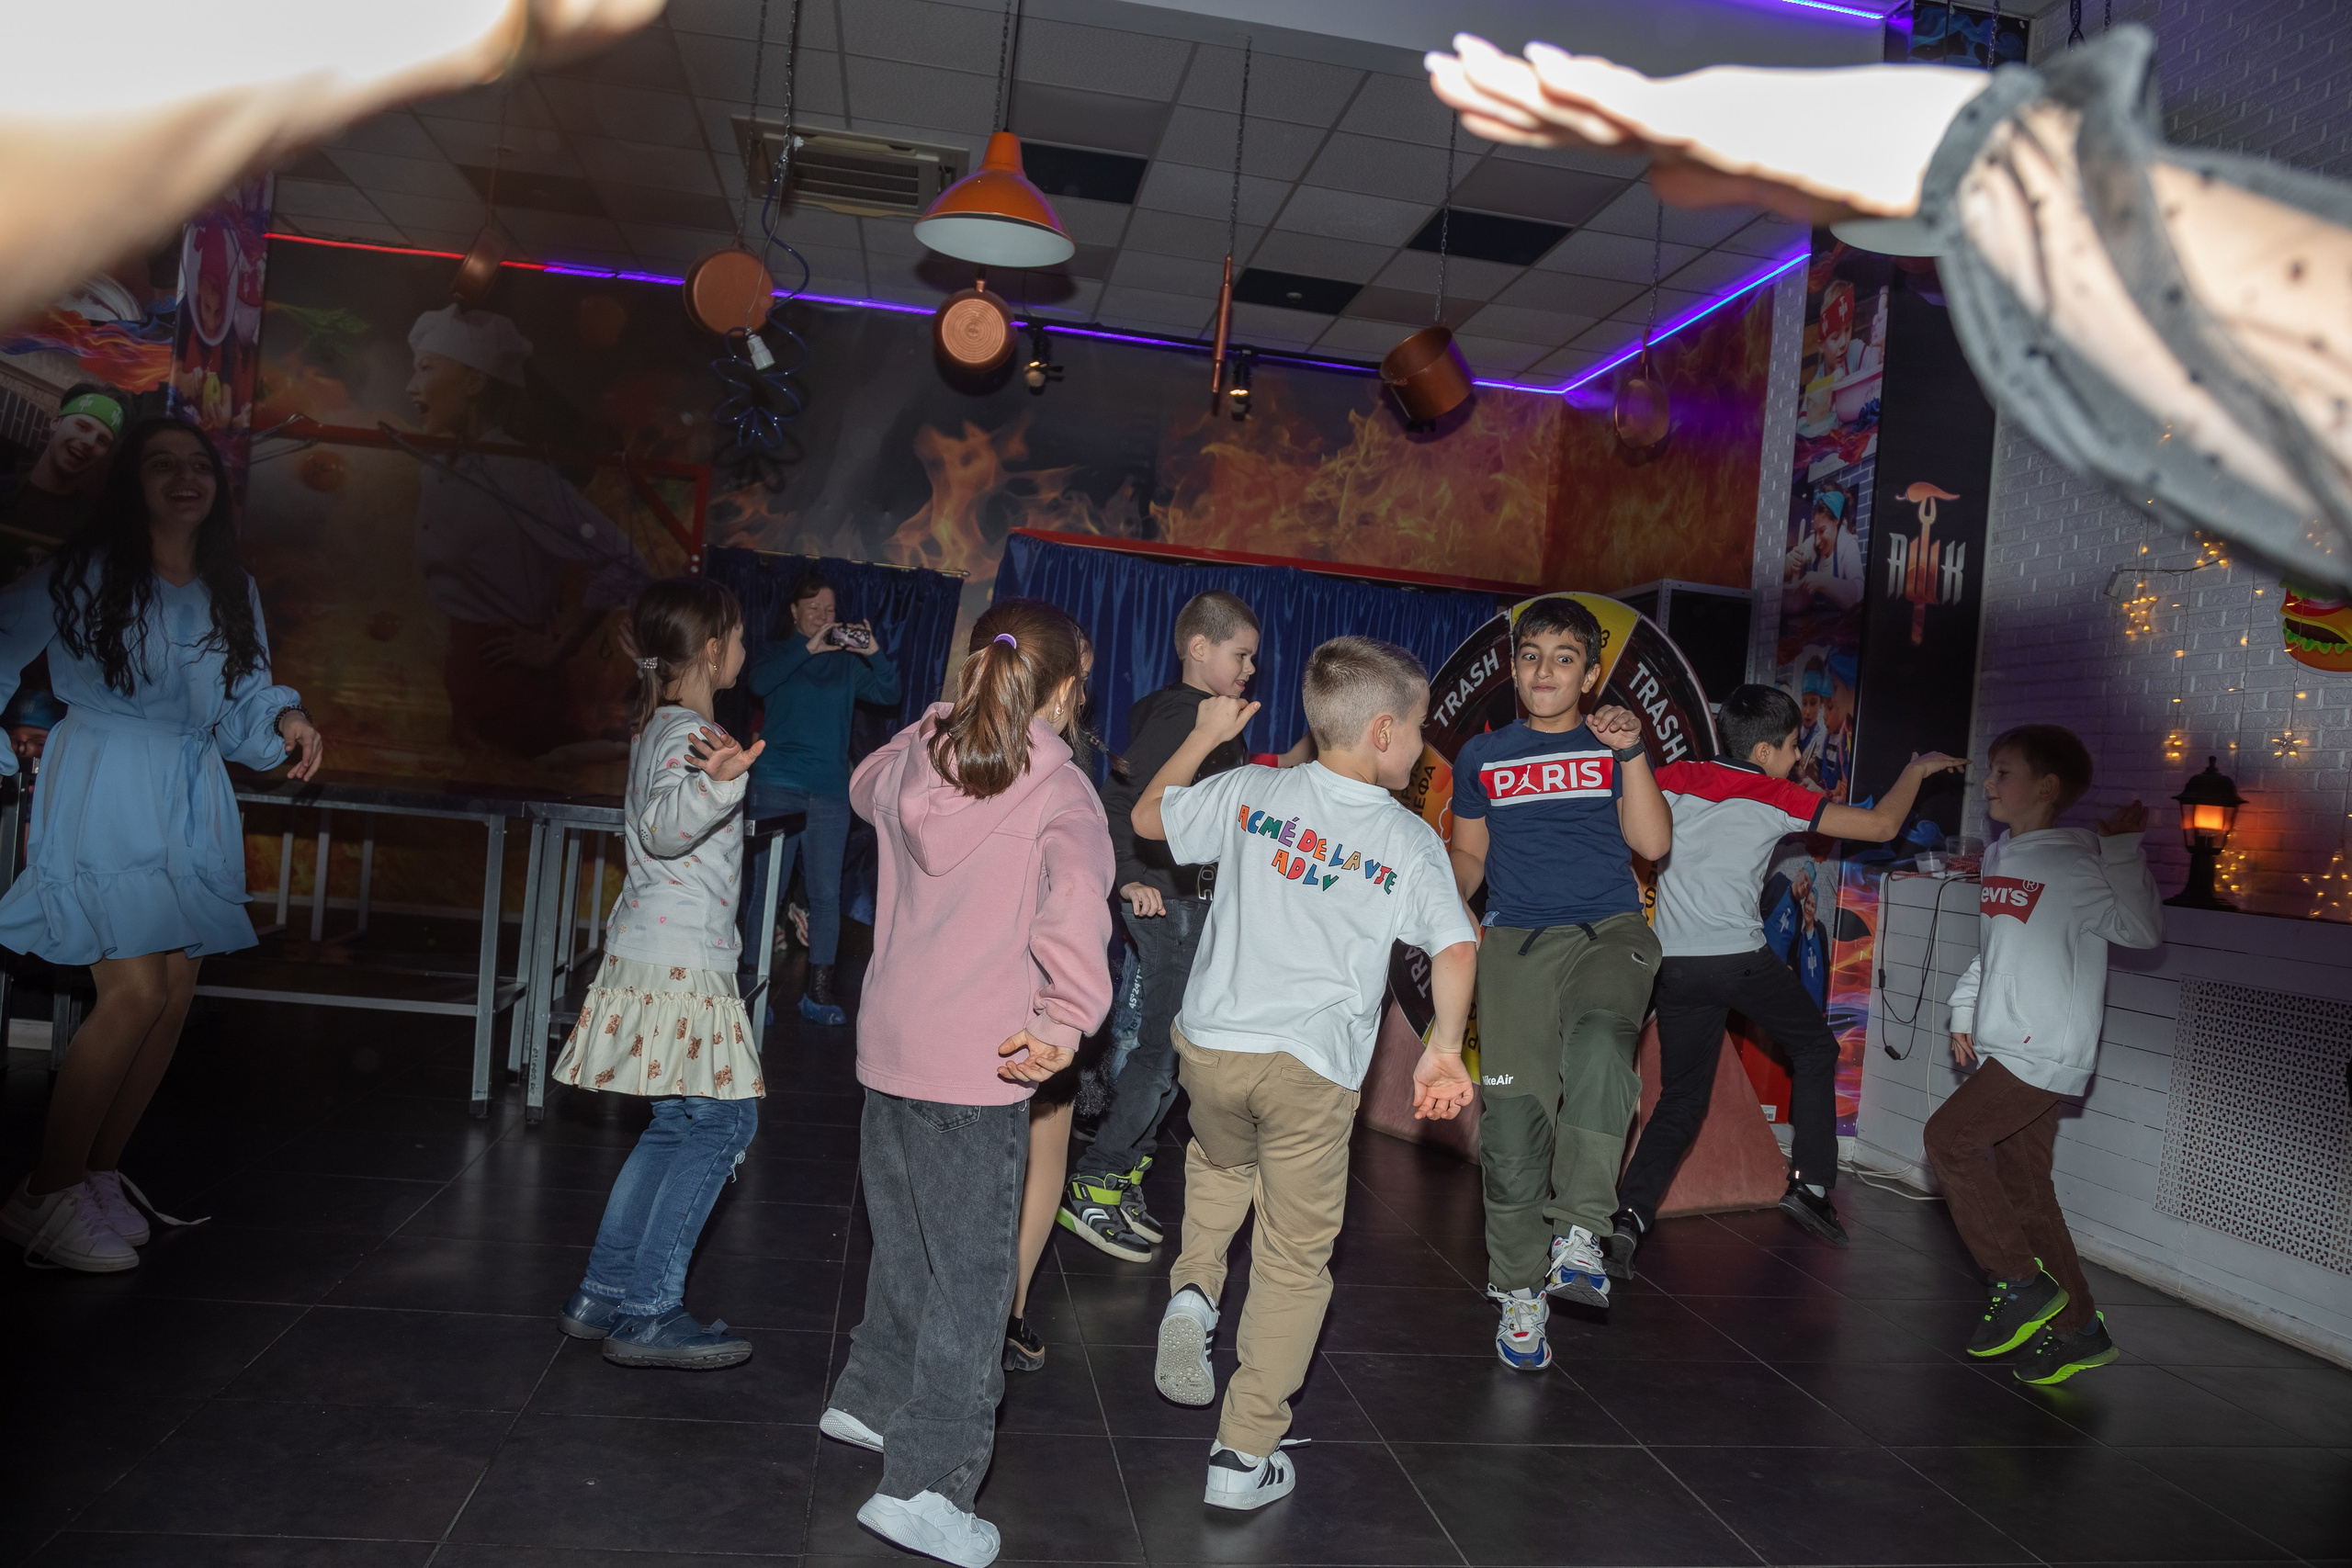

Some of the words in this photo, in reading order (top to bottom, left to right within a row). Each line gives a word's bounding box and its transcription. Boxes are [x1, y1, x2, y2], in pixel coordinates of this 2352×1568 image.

[1433, 648, 1499, 728] TRASH
[1628, 661, 1688, 764] TRASH
[1413, 765, 1436, 817] ЕФА
[1238, 805, 1300, 848] ACMÉ
[1296, 829, 1328, 862] DE
[1329, 843, 1362, 871] LA
[1364, 859, 1398, 896] VIE
[1272, 849, 1340, 892] ADLV
[1405, 944, 1430, 999] TRA
